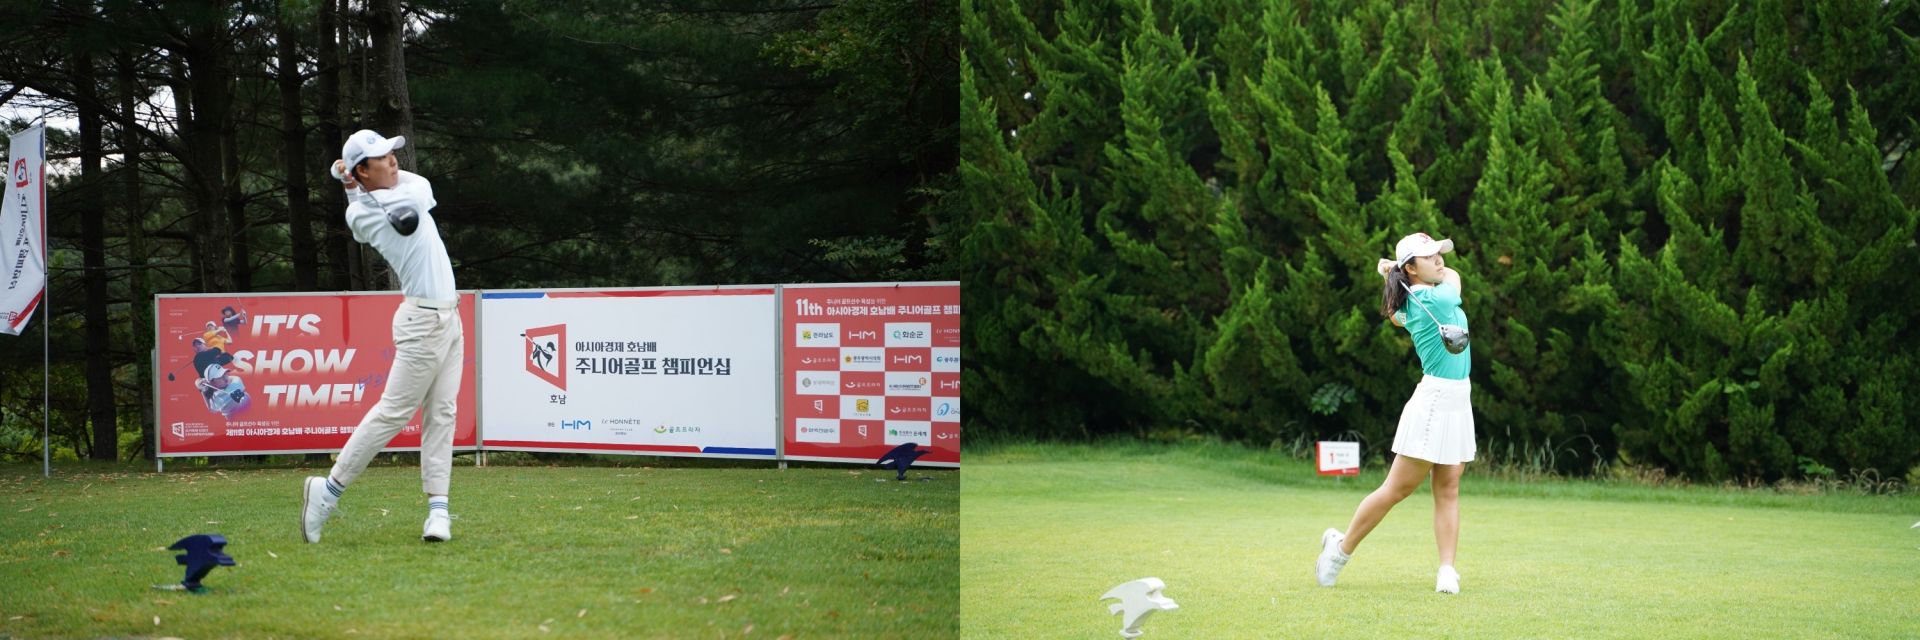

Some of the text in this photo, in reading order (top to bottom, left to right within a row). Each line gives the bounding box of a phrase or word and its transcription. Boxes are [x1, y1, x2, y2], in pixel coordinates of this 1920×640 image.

[796, 298, 823, 316] 11th
[826, 305, 869, 316] 아시아경제
[870, 305, 896, 316] 호남배
[898, 305, 941, 315] 주니어골프
[251, 313, 322, 337] IT'S
[902, 331, 924, 339] 화순군
[575, 341, 657, 353] 아시아경제 호남배
[232, 348, 357, 375] SHOW
[575, 357, 731, 376] 주니어골프 챔피언십
[263, 383, 366, 407] TIME!
[550, 394, 567, 405] 호남
[246, 428, 281, 436] 아시아경제
[281, 427, 303, 435] 호남배
[304, 426, 338, 435] 주니어골프
